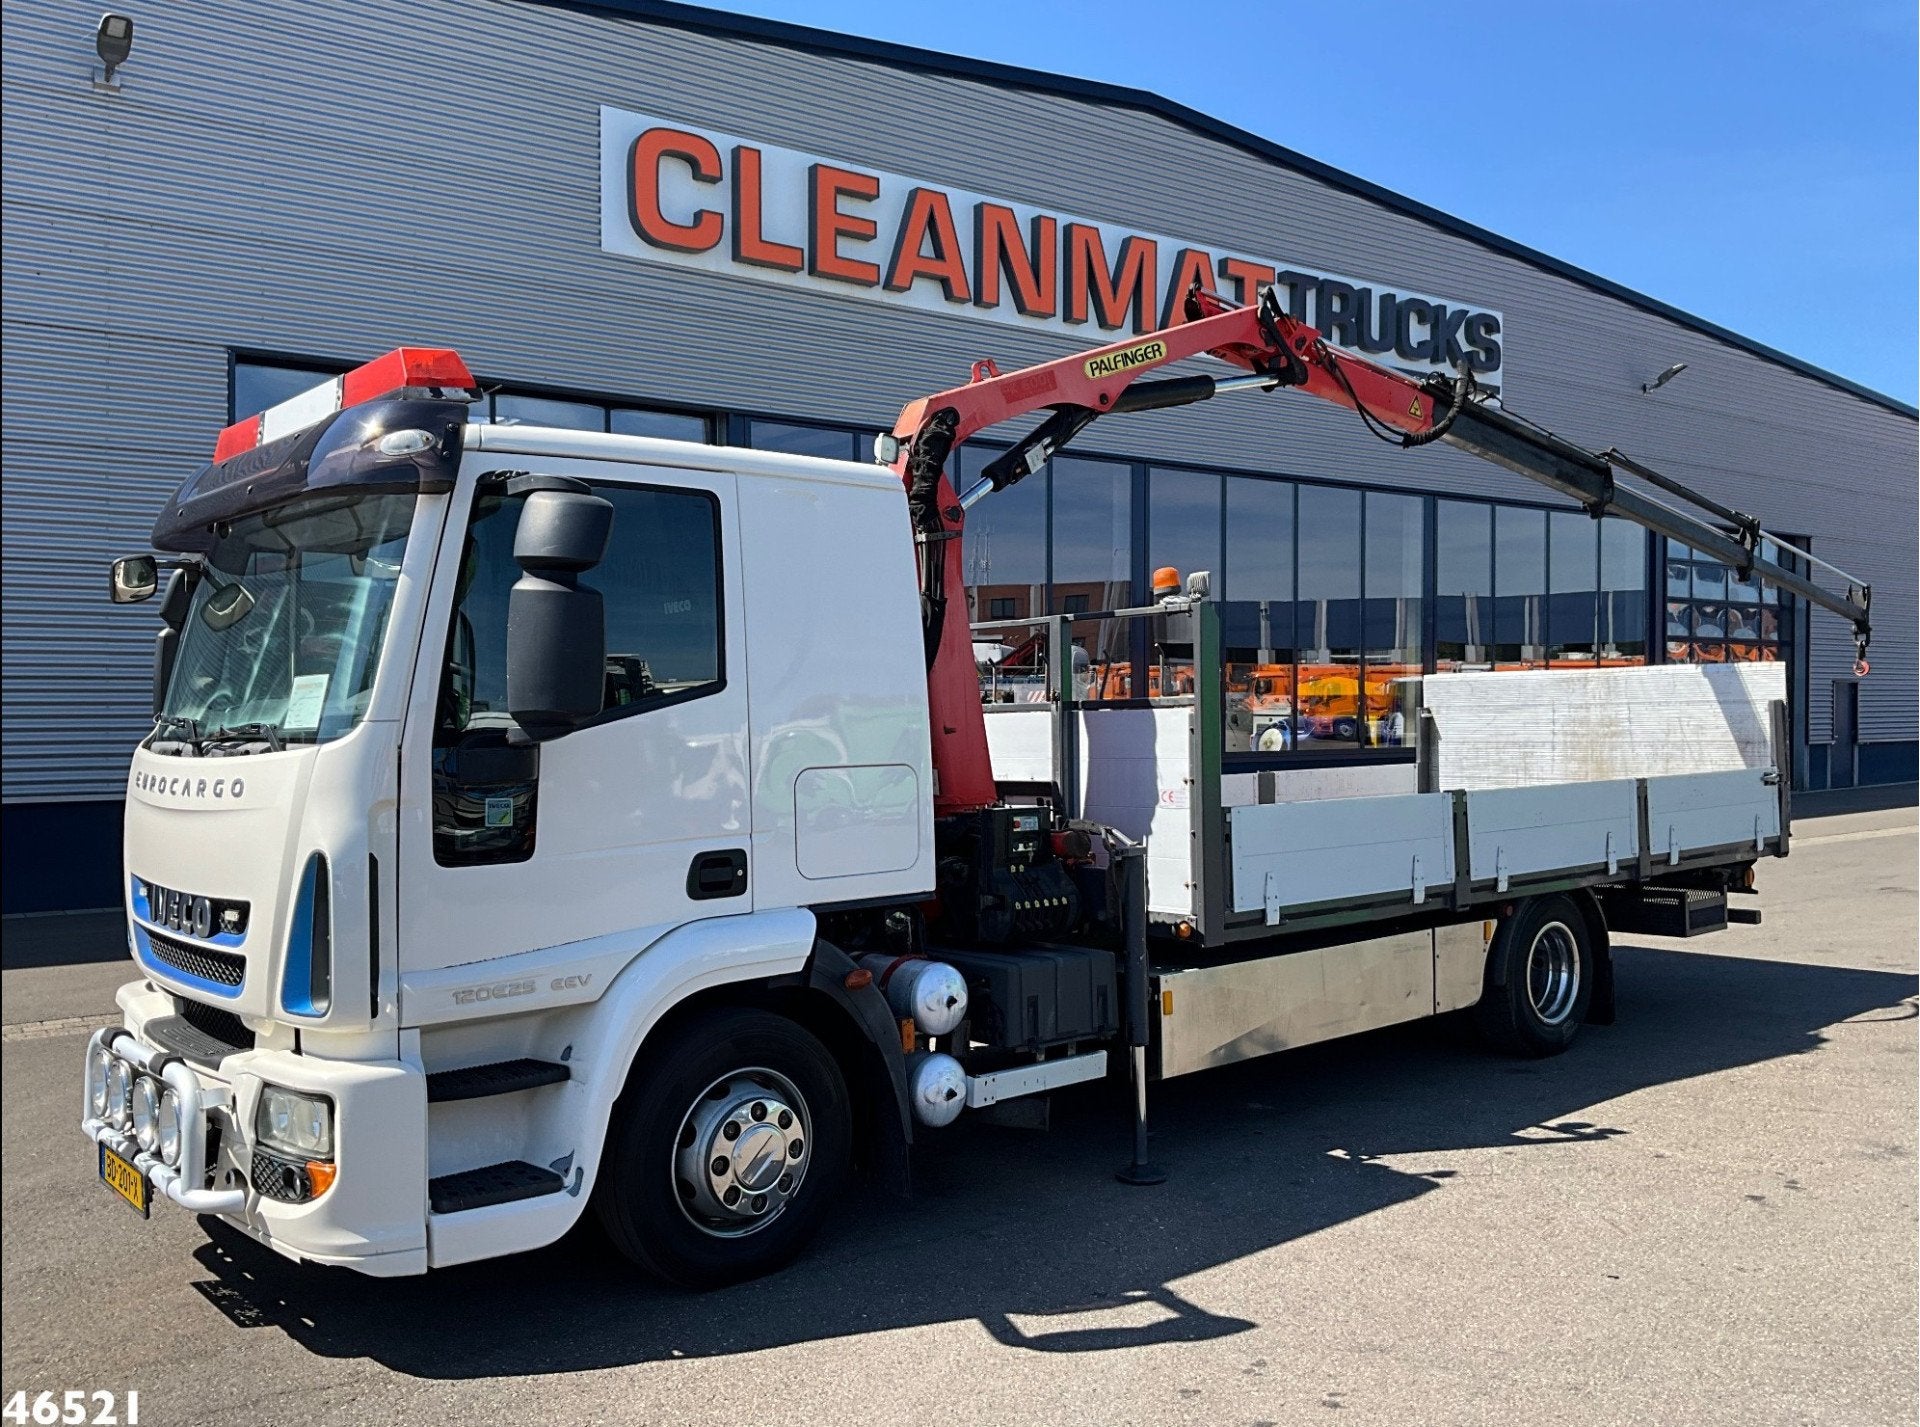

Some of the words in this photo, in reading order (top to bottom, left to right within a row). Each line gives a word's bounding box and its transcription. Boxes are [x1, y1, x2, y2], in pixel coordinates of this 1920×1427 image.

[626, 126, 1273, 336] CLEANMAT
[1277, 269, 1503, 374] TRUCKS
[1088, 342, 1163, 377] PALFINGER
[663, 599, 692, 615] IVECO
[134, 770, 246, 798] EUROCARGO
[150, 883, 212, 939] IVECO
[451, 979, 537, 1005] 120E25
[550, 973, 593, 991] EEV
